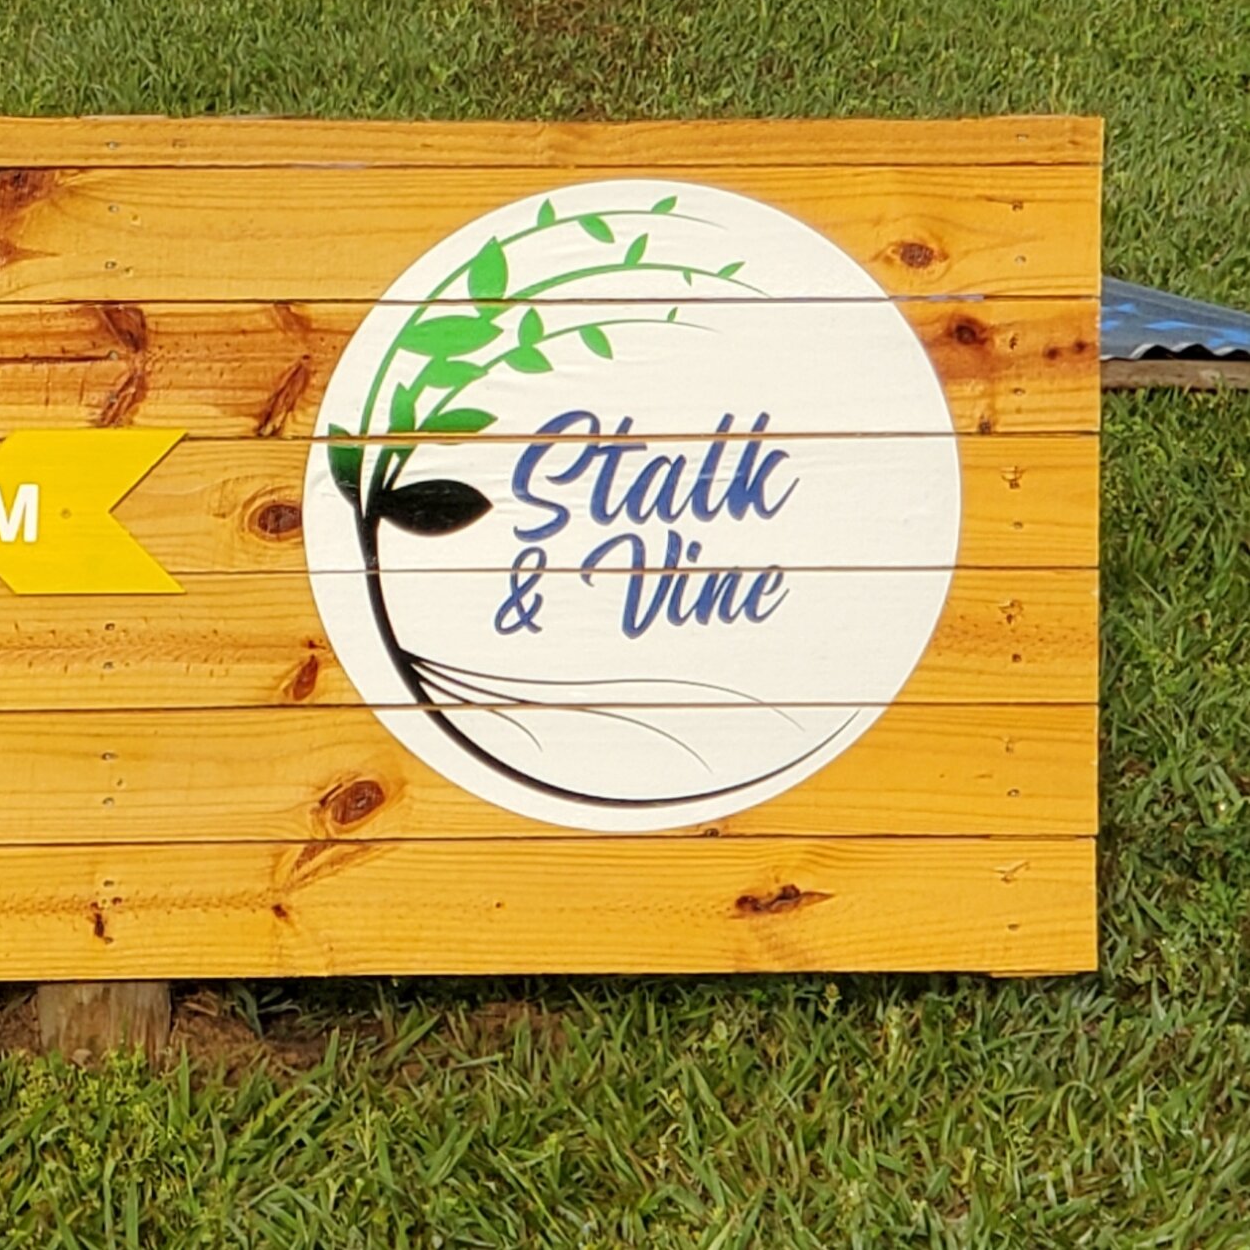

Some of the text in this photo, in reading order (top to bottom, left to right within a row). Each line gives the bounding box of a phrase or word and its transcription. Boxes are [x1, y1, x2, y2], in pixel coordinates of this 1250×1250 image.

[511, 410, 799, 543] Stalk
[494, 529, 790, 639] & Vine
